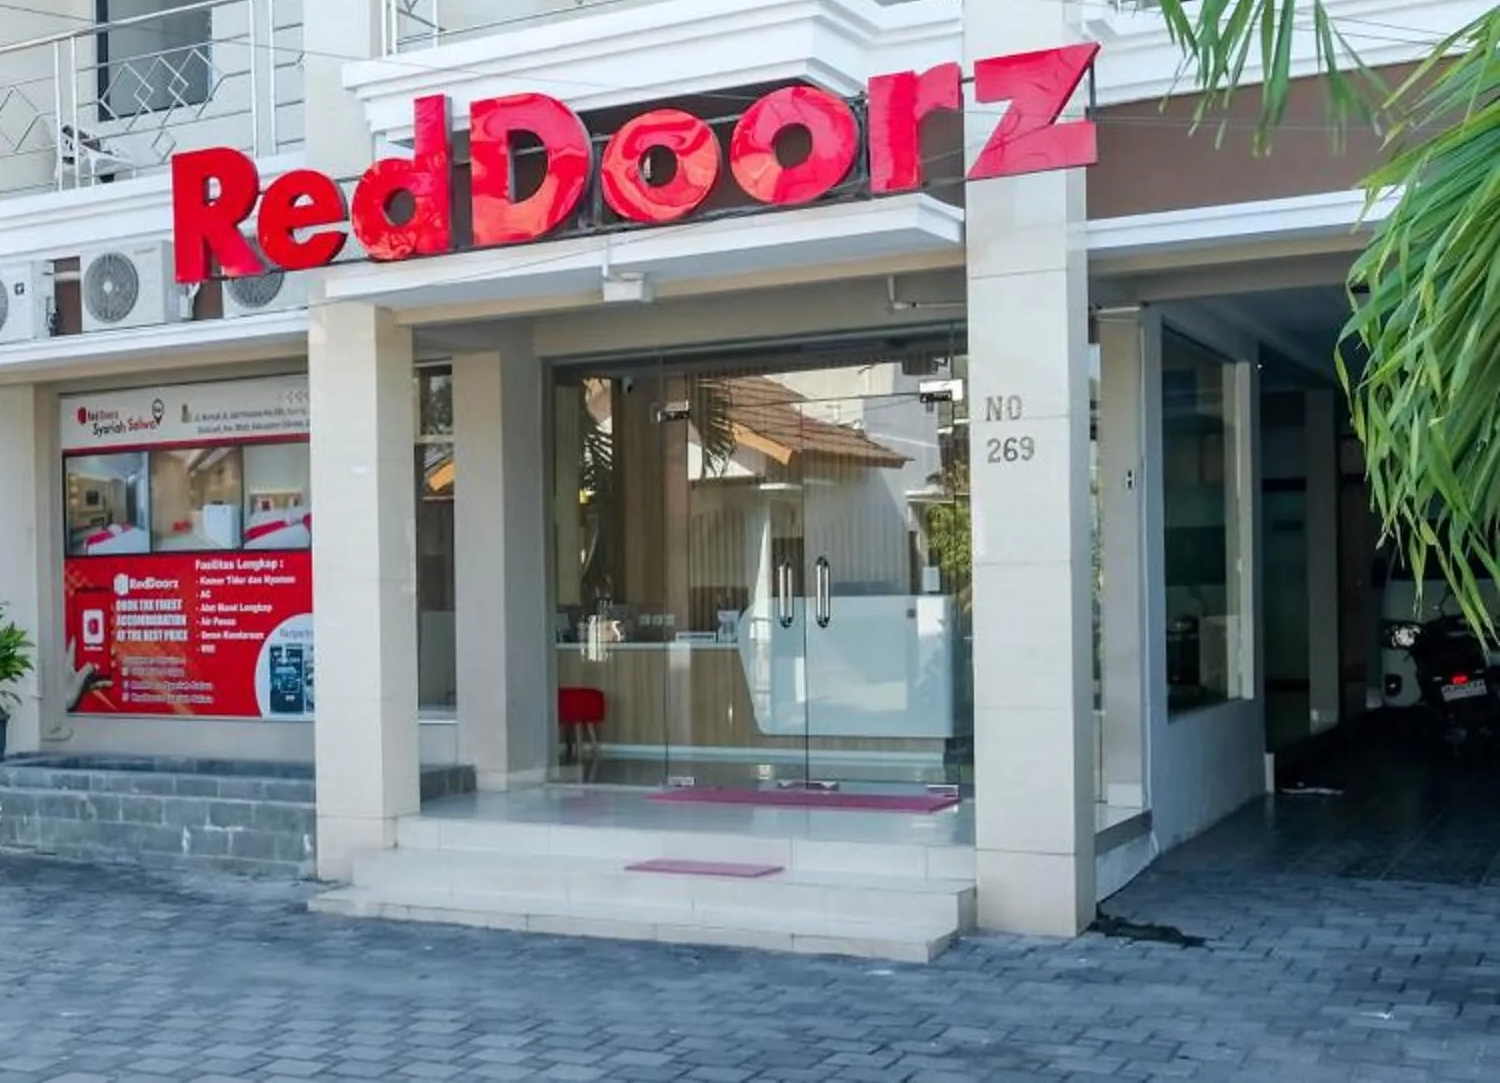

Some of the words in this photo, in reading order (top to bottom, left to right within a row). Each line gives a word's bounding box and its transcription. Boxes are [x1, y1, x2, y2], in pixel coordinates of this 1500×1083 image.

[171, 42, 1101, 283] RedDoorz
[984, 395, 1023, 422] NO
[986, 436, 1035, 463] 269
